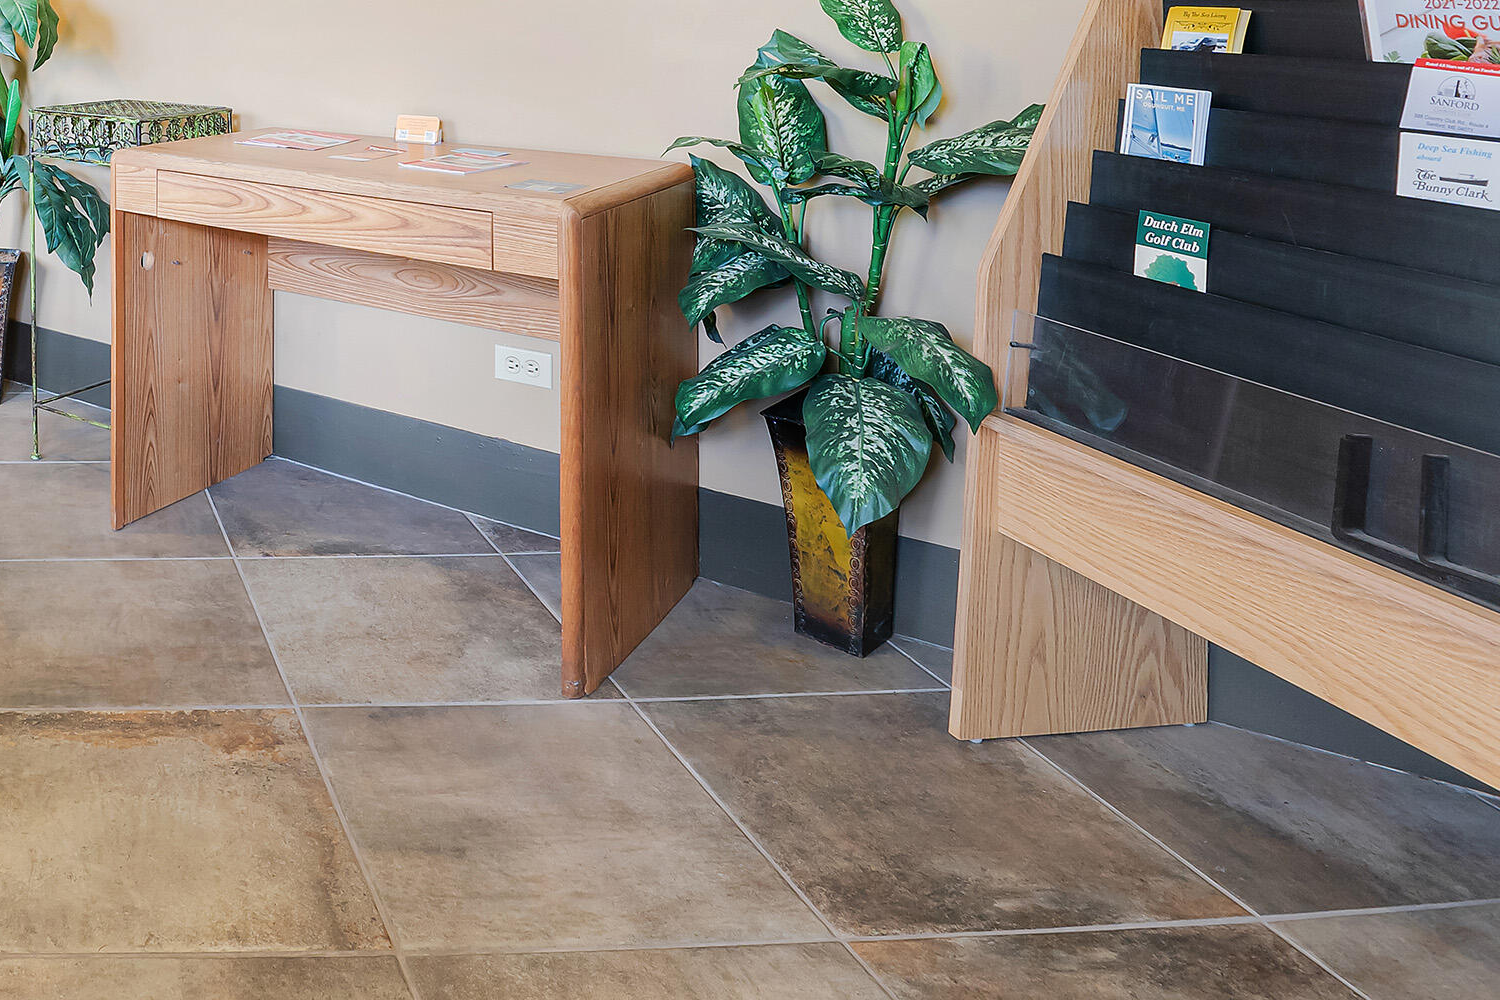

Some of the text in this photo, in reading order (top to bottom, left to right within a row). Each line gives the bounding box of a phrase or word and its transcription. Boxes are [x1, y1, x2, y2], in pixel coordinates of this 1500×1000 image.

[1396, 14, 1466, 31] DINING
[1136, 90, 1194, 106] SAIL ME
[1430, 96, 1480, 111] SANFORD
[1418, 142, 1492, 158] Deep Sea Fishing
[1415, 168, 1436, 180] The
[1413, 181, 1492, 202] Bunny Clark
[1143, 216, 1204, 238] Dutch Elm
[1145, 232, 1200, 253] Golf Club
